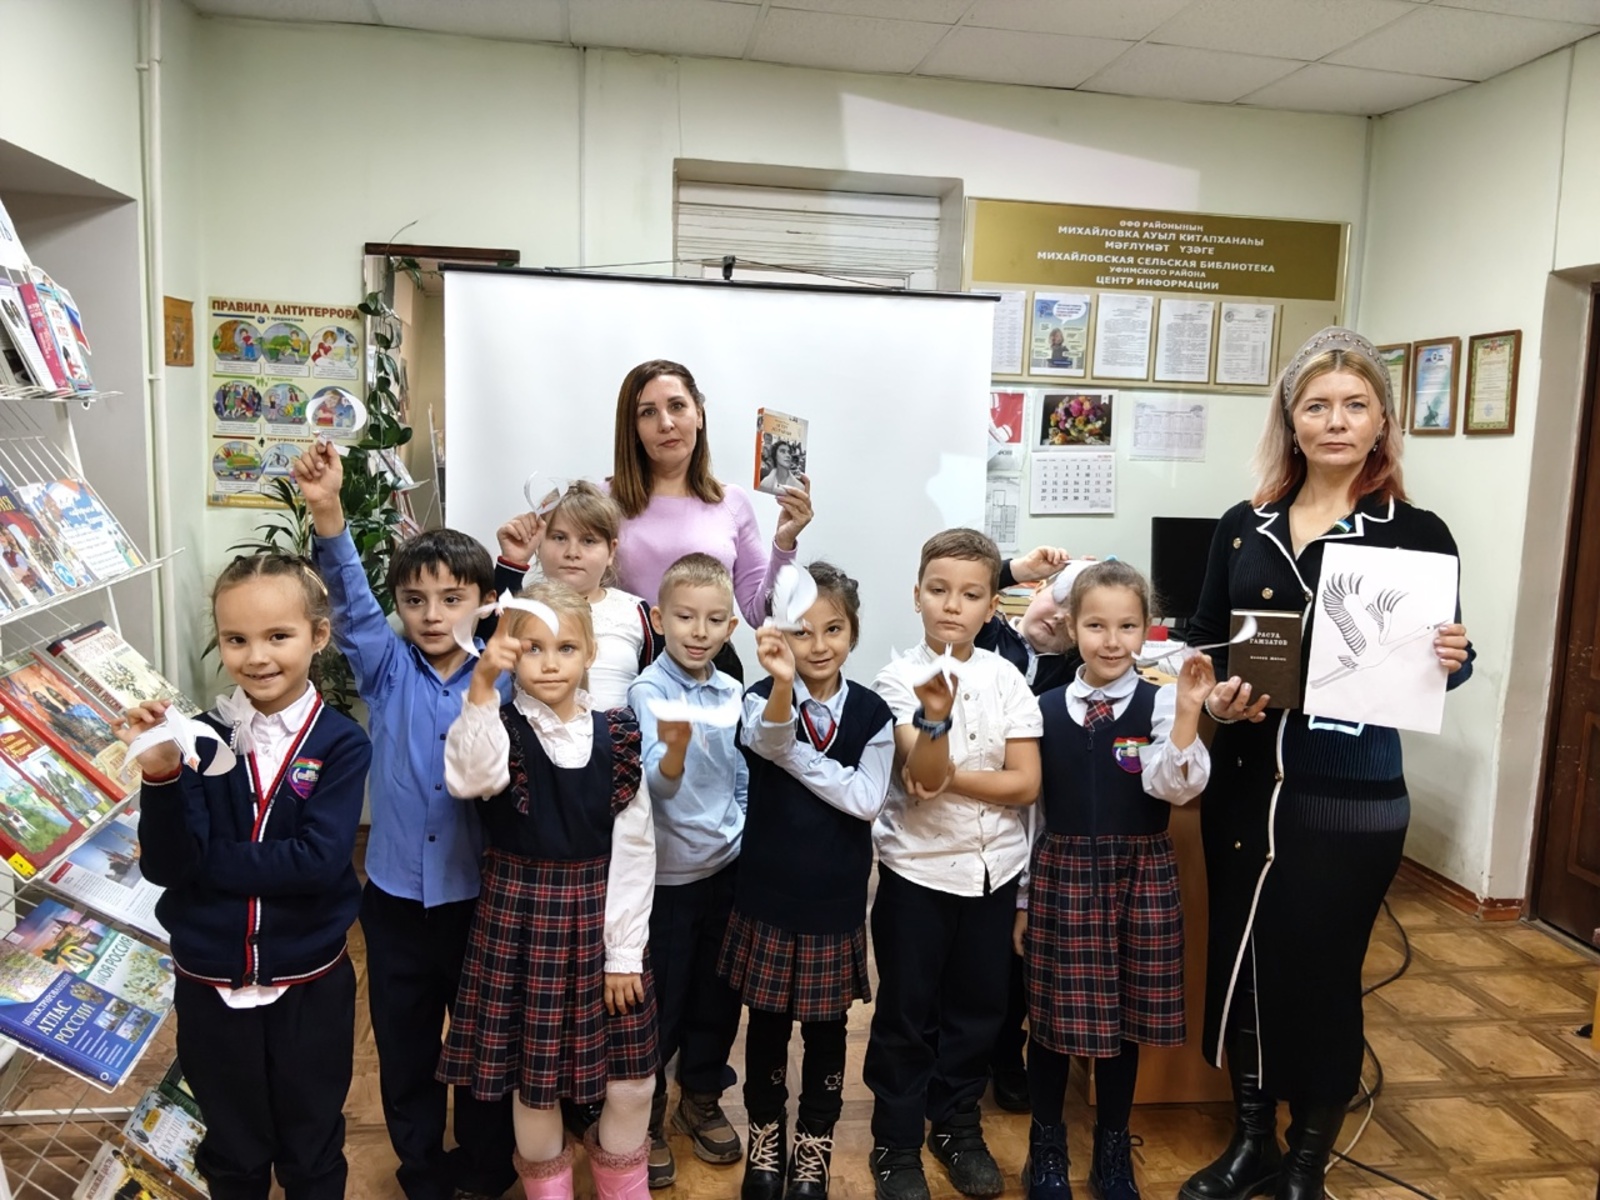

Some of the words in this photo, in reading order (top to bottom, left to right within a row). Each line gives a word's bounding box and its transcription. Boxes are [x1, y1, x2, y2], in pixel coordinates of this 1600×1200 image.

[1058, 225, 1140, 239] МИХАЙЛОВКА
[1142, 232, 1176, 241] АУЫЛ
[1037, 251, 1134, 264] МИХАЙЛОВСКАЯ
[1137, 257, 1197, 268] СЕЛЬСКАЯ
[1199, 260, 1275, 273] БИБЛИОТЕКА
[1109, 266, 1167, 276] УФИМСКОГО
[1169, 269, 1206, 278] РАЙОНА
[1096, 275, 1134, 286] ЦЕНТР
[1136, 277, 1220, 290] ИНФОРМАЦИИ
[212, 300, 270, 315] ПРАВИЛА
[274, 304, 360, 320] АНТИТЕРРОРА
[105, 935, 133, 967] РОССИЯ
[37, 999, 72, 1035] АТЛАС
[56, 1001, 95, 1045] РОССИИ
